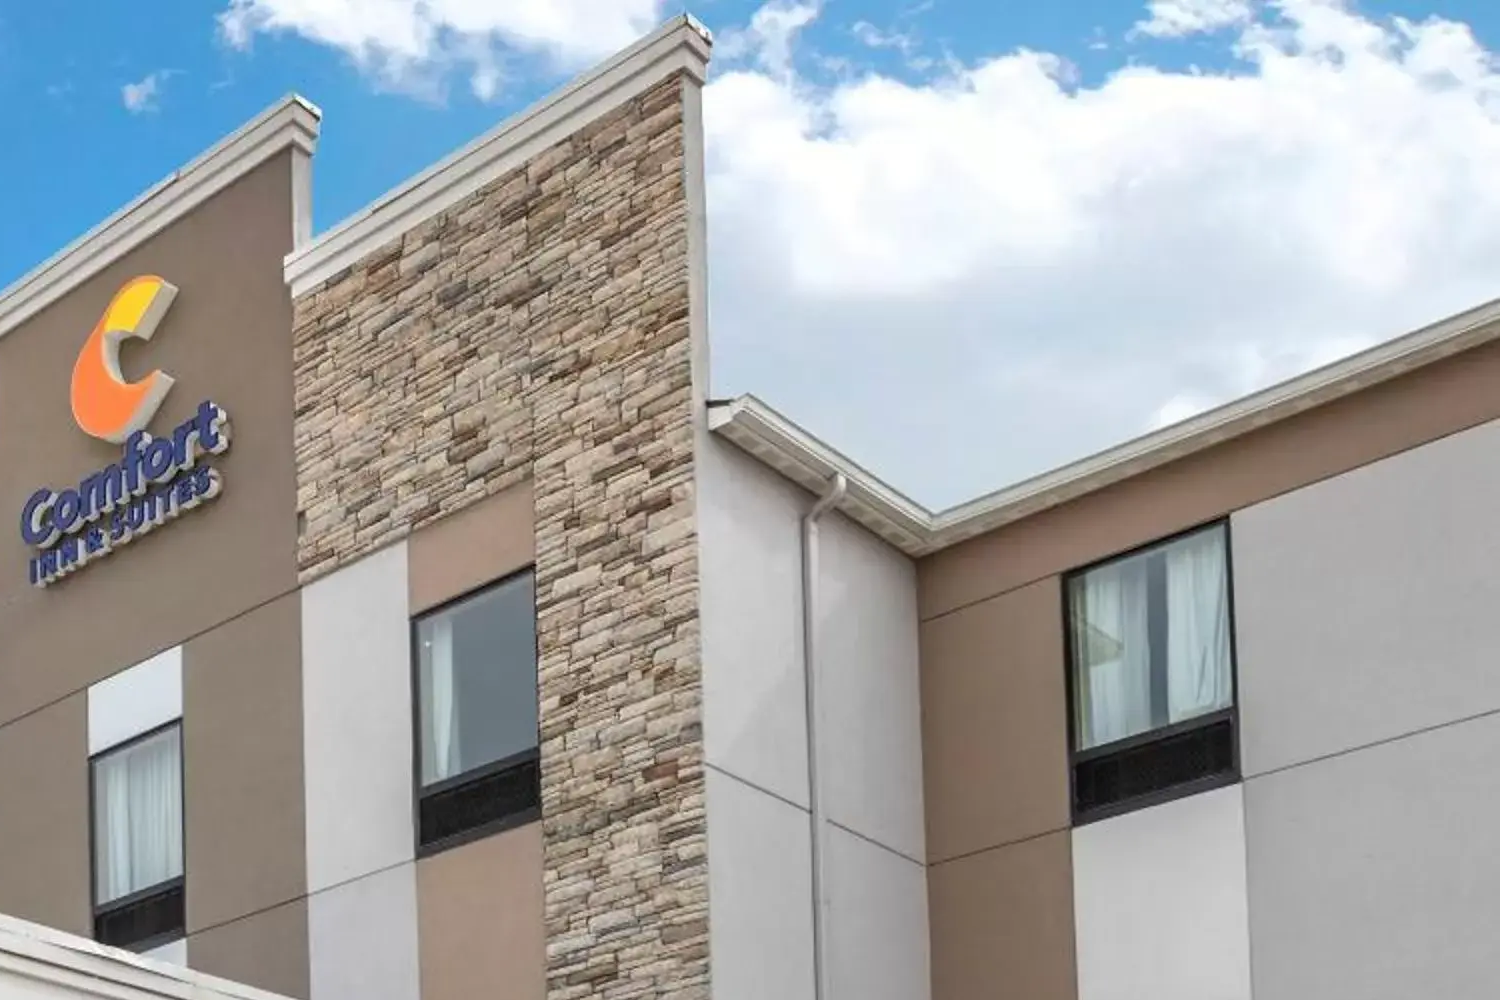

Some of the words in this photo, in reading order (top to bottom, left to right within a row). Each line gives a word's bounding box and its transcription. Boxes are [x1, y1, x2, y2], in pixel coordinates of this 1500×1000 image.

[21, 400, 228, 547] Comfort
[29, 537, 87, 588] INN
[109, 464, 222, 545] SUITES
